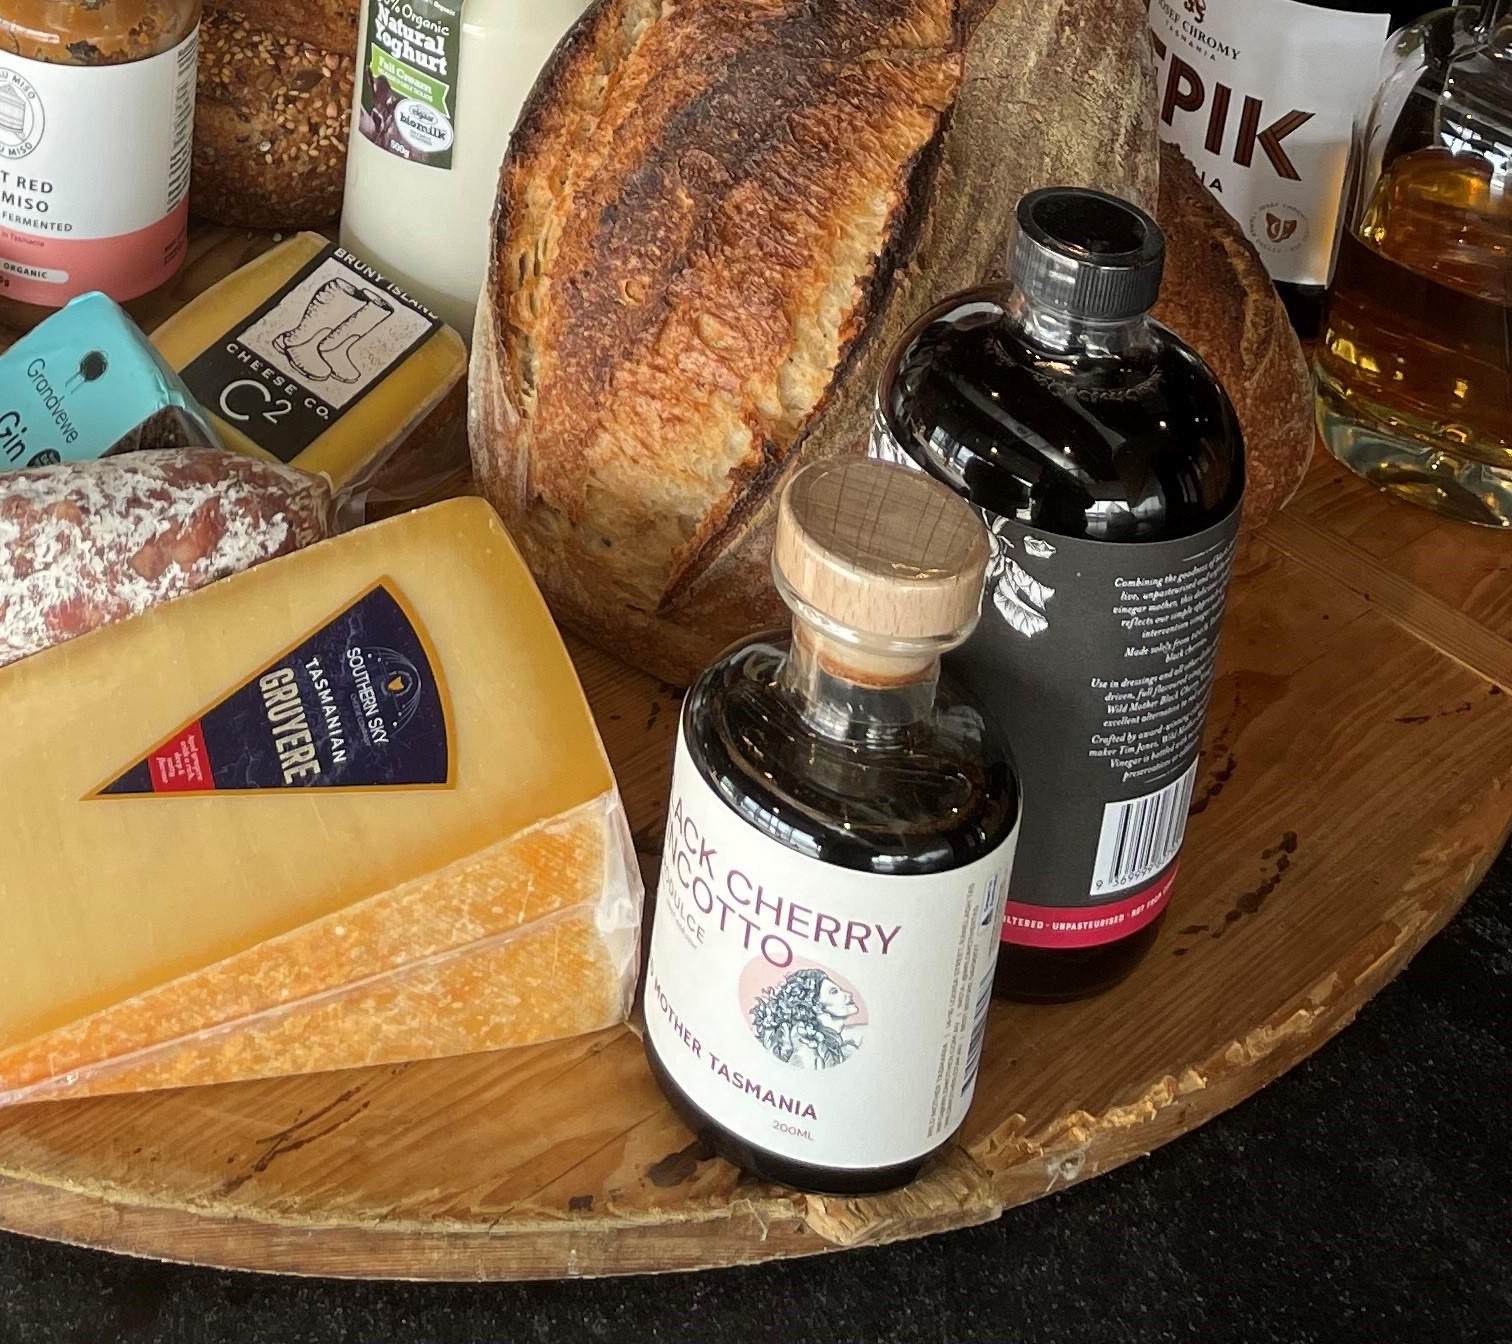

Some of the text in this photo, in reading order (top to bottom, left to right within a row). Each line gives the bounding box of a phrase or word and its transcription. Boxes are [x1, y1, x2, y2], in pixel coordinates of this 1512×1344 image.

[377, 2, 445, 56] Natural
[401, 3, 450, 37] Organic
[375, 18, 448, 76] Yoghurt
[1182, 17, 1241, 61] CHROMY
[12, 75, 36, 100] MISO
[394, 67, 433, 94] Cream
[399, 111, 447, 141] biomilk
[8, 141, 33, 157] MISO
[16, 177, 53, 194] RED
[1, 191, 49, 213] MISO
[2, 210, 73, 233] FERMENTED
[3, 261, 47, 279] ORGANIC
[334, 247, 384, 282] BRUNY
[225, 342, 330, 420] CHEESE CO.
[24, 356, 80, 444] Grandvewe
[218, 376, 293, 426] C2
[1115, 577, 1163, 588] Combining
[1113, 606, 1147, 616] vinegar
[1121, 617, 1153, 630] reflects
[1124, 646, 1149, 657] Made
[1091, 677, 1108, 688] Use
[1110, 679, 1119, 688] in
[1120, 675, 1158, 688] dressings
[346, 645, 390, 746] SOUTHERN SKY
[1136, 687, 1153, 701] full
[304, 656, 347, 764] TASMANIAN
[1108, 704, 1128, 714] Wild
[1129, 699, 1159, 712] Mother
[258, 665, 324, 785] GRUYERE
[1103, 716, 1140, 727] excellent
[1091, 732, 1127, 746] Crafted
[1127, 731, 1137, 743] by
[1089, 748, 1118, 757] maker
[1119, 745, 1135, 755] Tim
[1110, 757, 1142, 768] Vinegar
[726, 868, 903, 957] CHERRY
[1052, 913, 1125, 931] UNPASTEURISED
[653, 975, 818, 1121] MOTHER TASMANIA
[772, 1120, 815, 1142] 200ML
